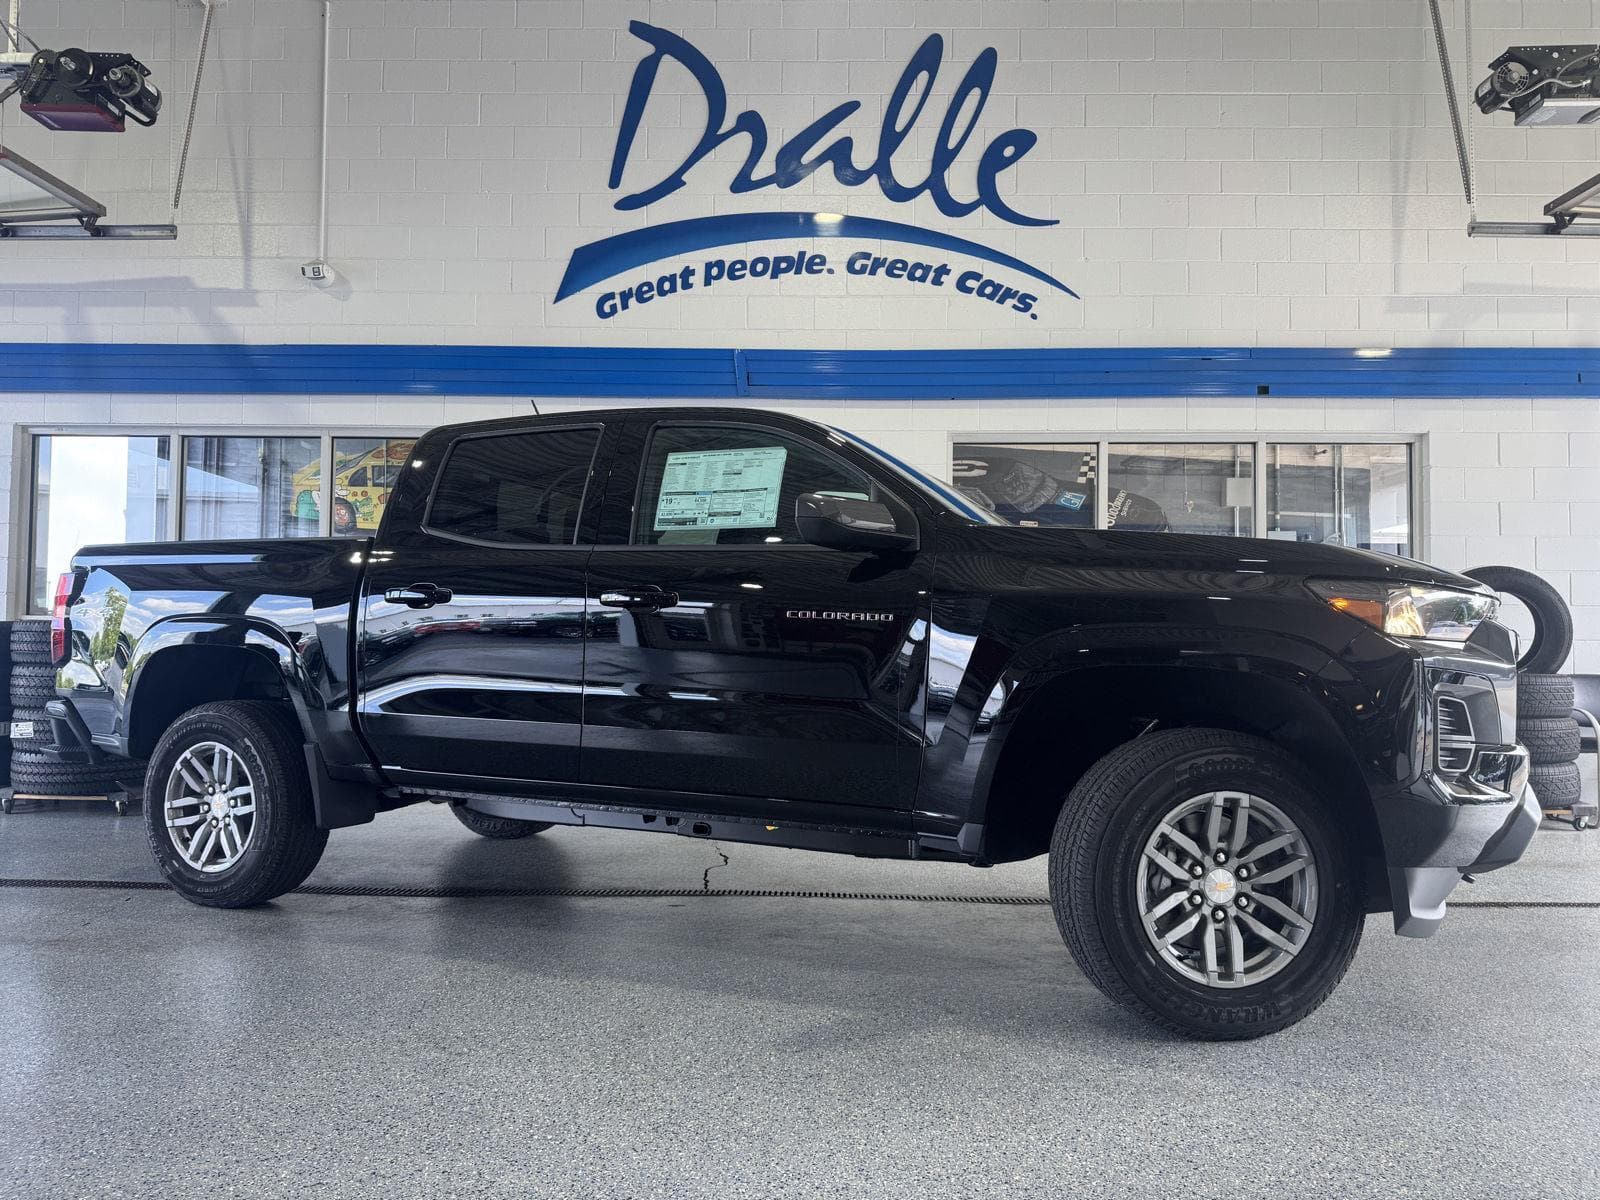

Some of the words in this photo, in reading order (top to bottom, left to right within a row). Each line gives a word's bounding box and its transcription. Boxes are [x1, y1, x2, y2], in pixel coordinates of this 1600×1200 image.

[607, 20, 1061, 227] Dralle
[596, 266, 695, 319] Great
[704, 252, 836, 286] people.
[846, 252, 951, 286] Great
[957, 271, 1038, 319] Cars.
[786, 610, 894, 621] COLORADO
